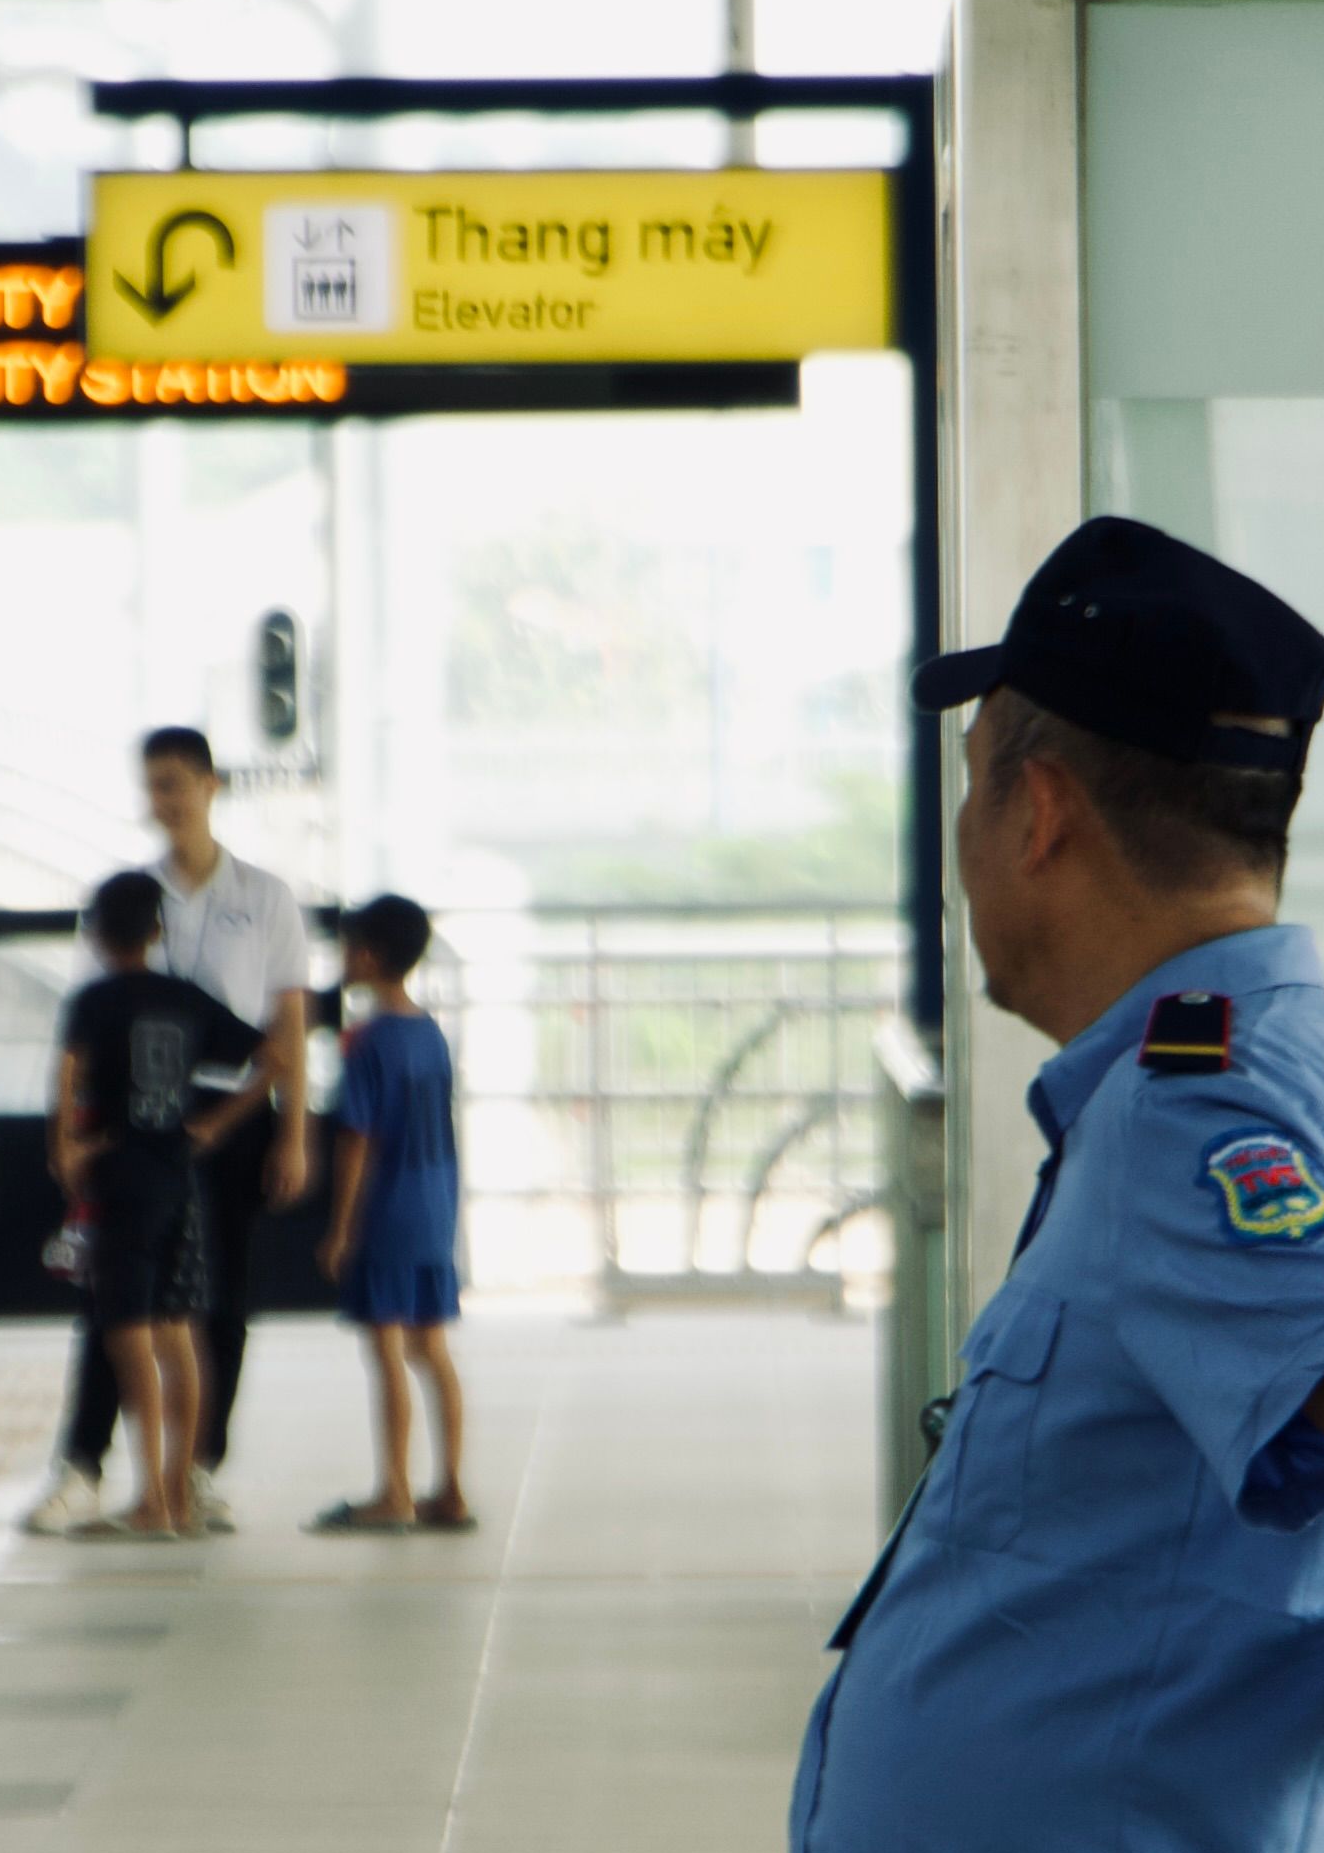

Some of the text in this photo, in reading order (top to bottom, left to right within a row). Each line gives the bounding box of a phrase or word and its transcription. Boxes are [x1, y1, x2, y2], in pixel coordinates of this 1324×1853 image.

[414, 202, 772, 277] Thang máy
[413, 291, 595, 331] Elevator
